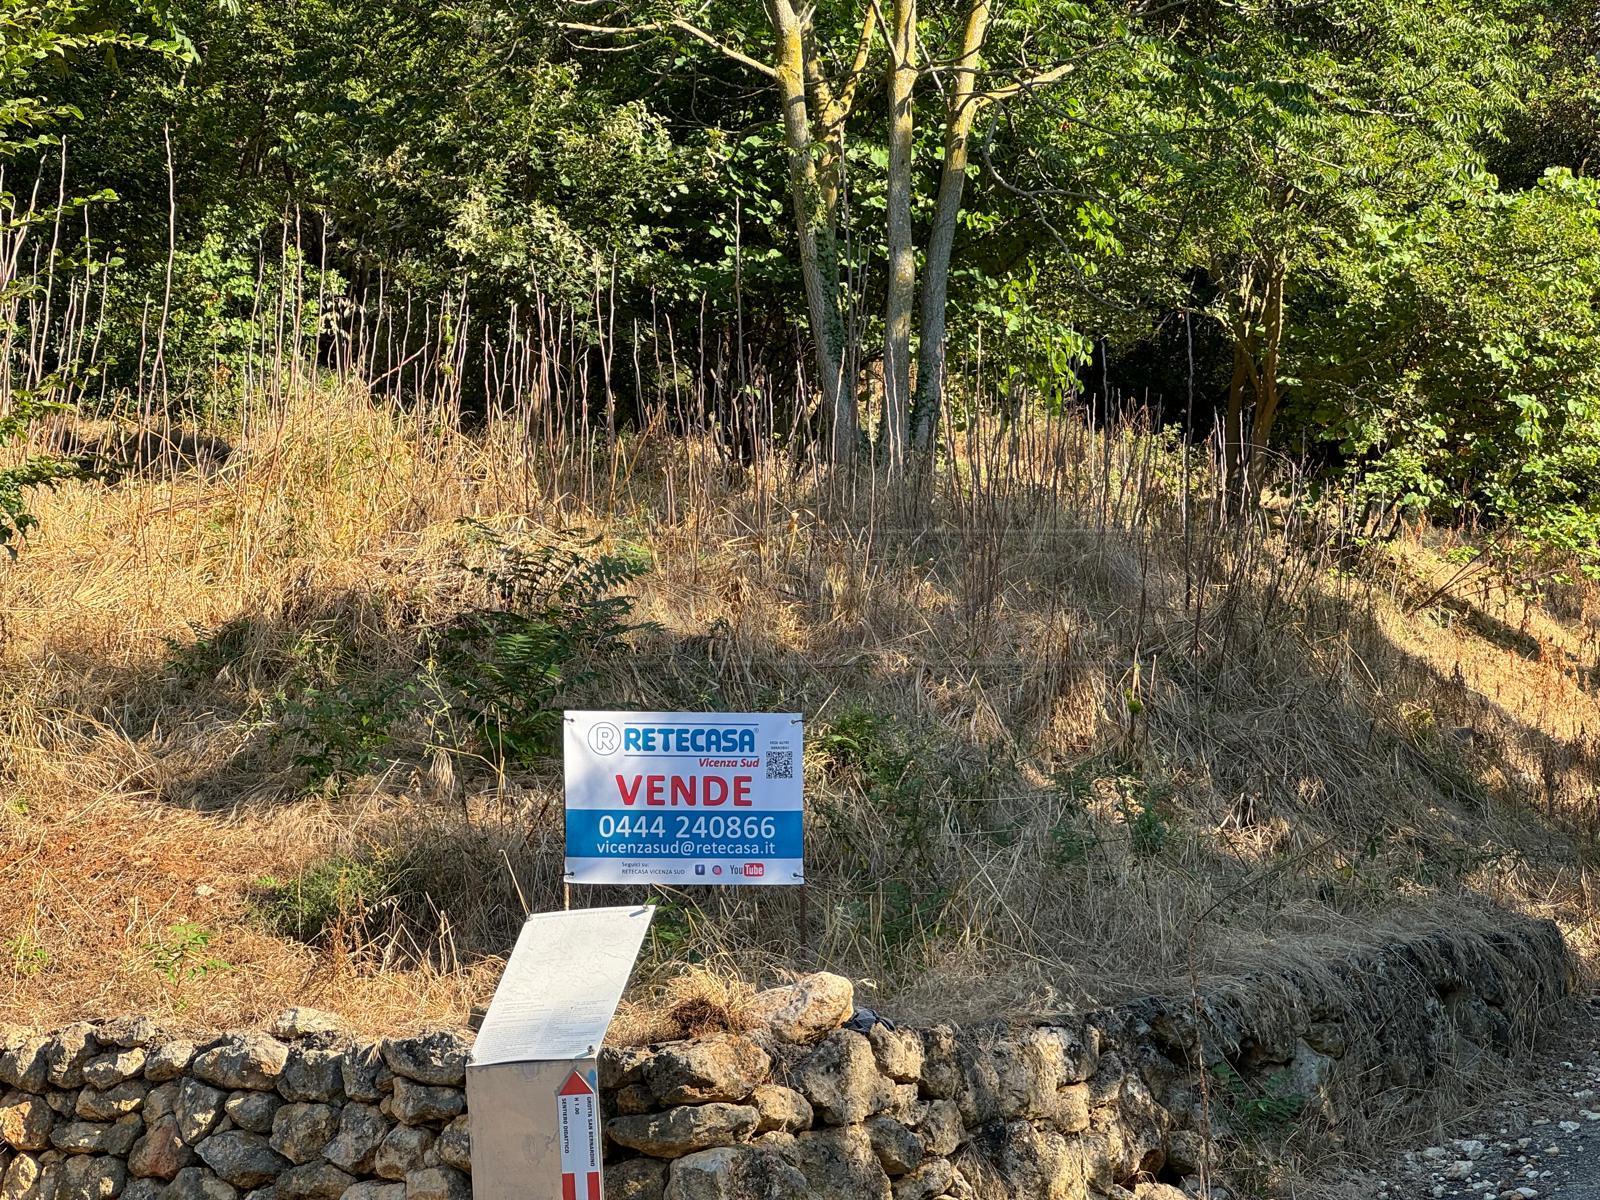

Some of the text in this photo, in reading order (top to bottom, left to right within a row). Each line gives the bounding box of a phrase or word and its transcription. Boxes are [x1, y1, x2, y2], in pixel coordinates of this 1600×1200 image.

[624, 728, 755, 753] RETECASA
[698, 758, 759, 768] Vicenza Sud
[615, 775, 753, 806] VENDE
[599, 815, 775, 839] 0444 240866
[597, 840, 775, 856] vicenzasud@retecasa.it
